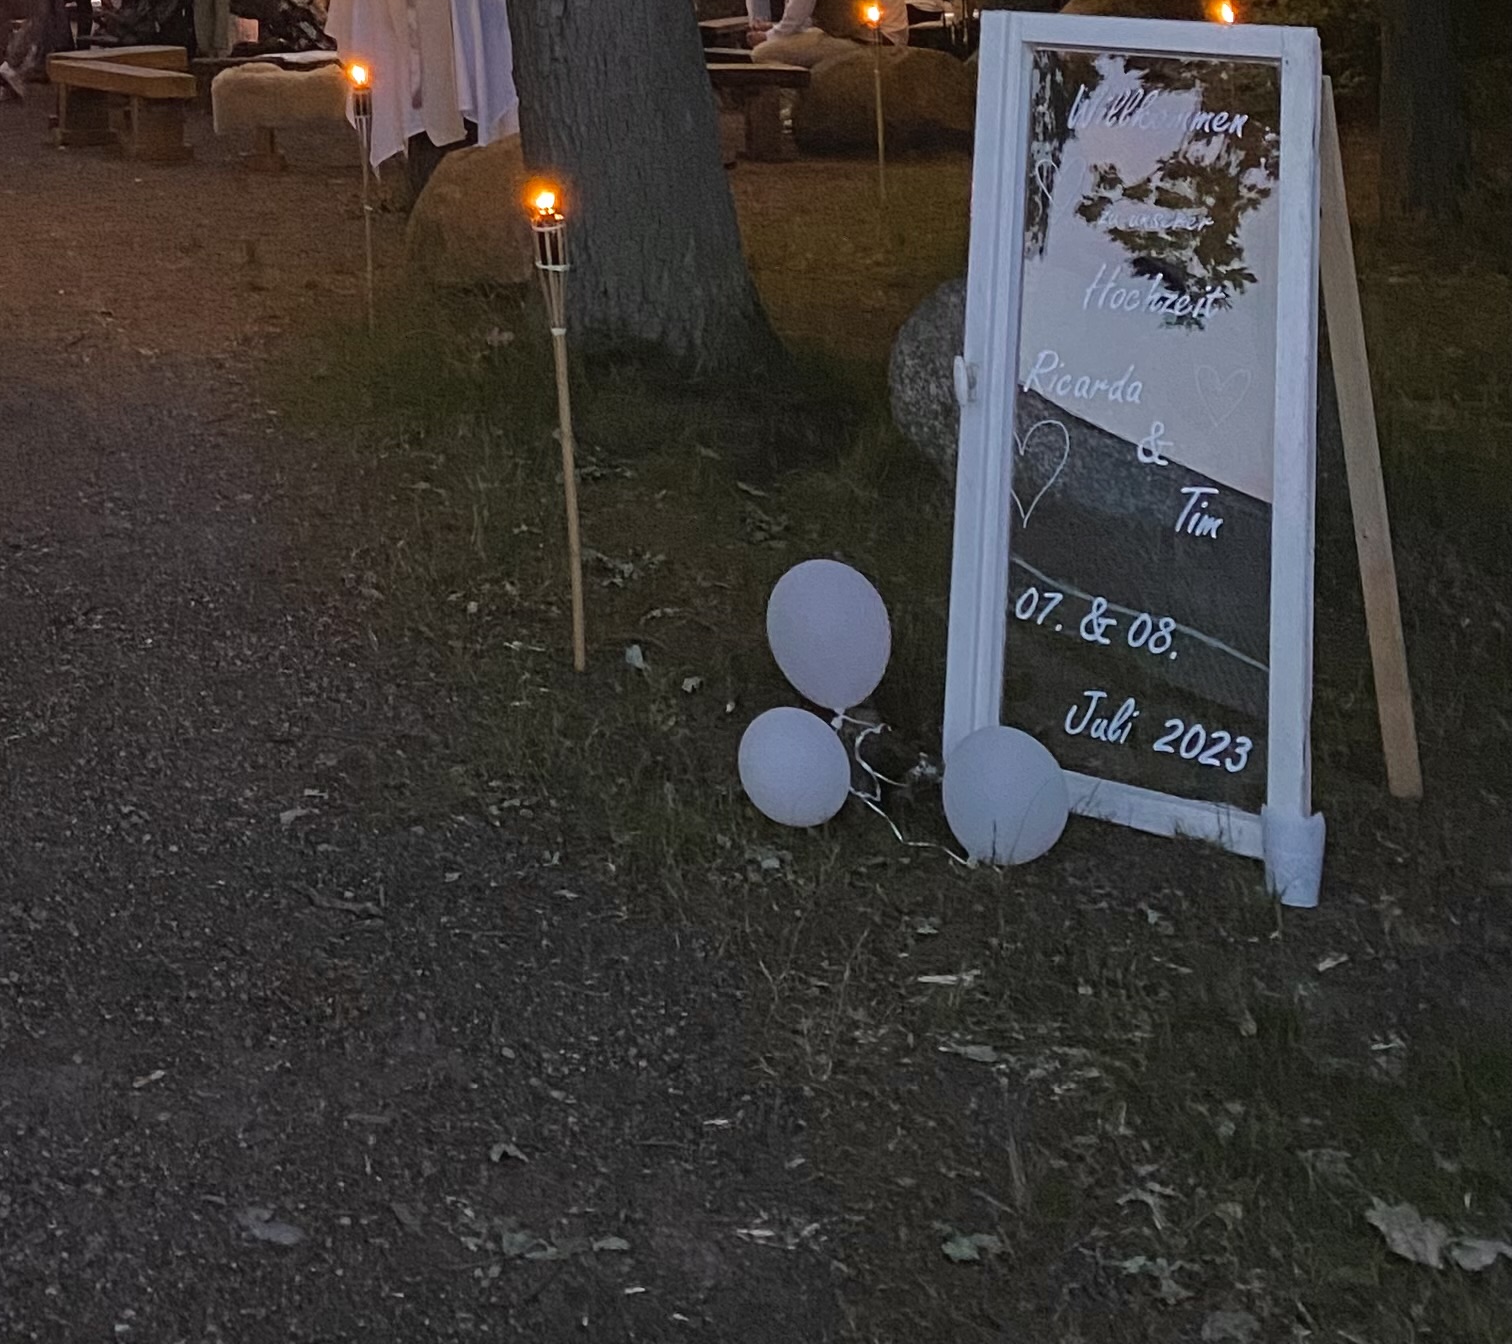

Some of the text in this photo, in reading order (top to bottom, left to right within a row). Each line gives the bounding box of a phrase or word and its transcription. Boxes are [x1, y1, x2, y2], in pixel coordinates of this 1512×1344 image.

[1067, 83, 1249, 138] Willkommen
[1084, 264, 1226, 319] Hochzeit
[1023, 349, 1143, 403] Ricarda
[1136, 421, 1174, 466] &
[1174, 486, 1224, 539] Tim
[1015, 587, 1178, 660] 07. & 08.
[1063, 690, 1253, 773] Juli 2023
